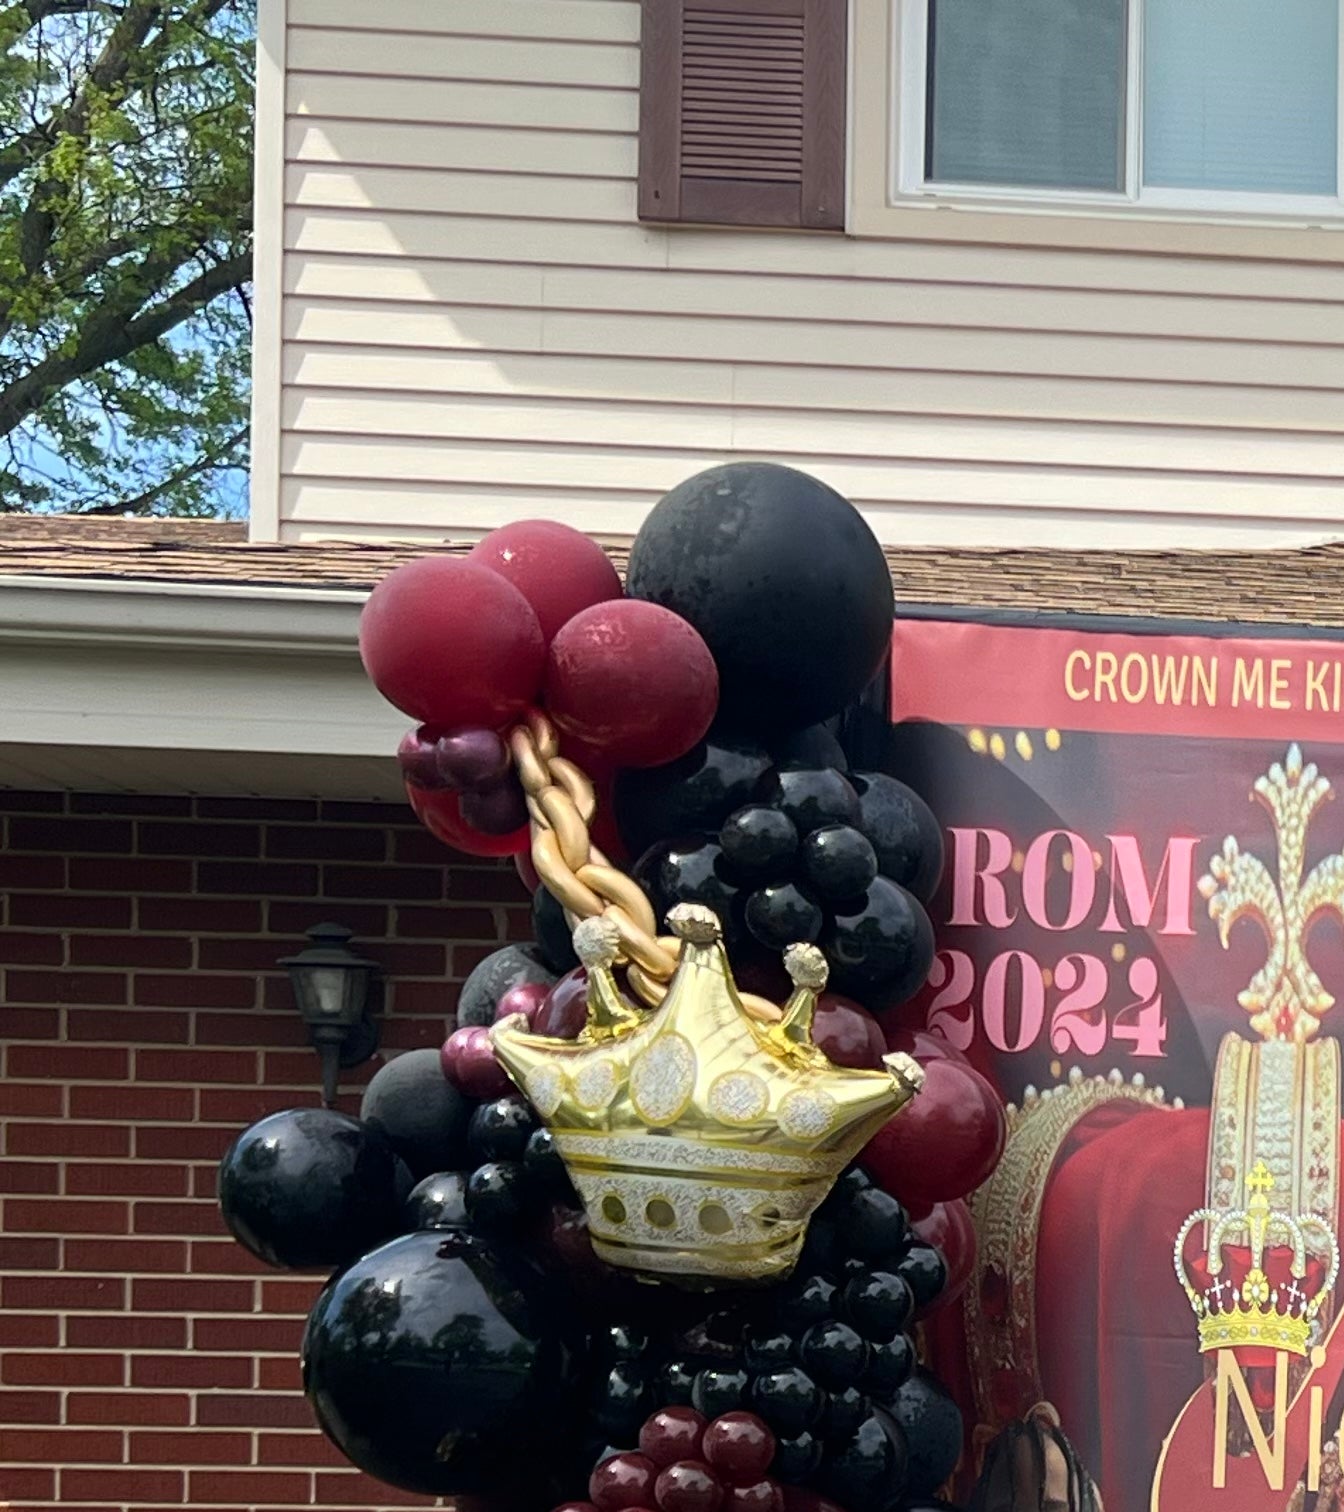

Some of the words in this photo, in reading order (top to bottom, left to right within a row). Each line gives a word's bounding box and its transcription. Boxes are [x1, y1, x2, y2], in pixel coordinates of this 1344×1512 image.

[1064, 649, 1218, 708] CROWN
[1230, 657, 1293, 709] ME
[944, 826, 1202, 936] ROM
[926, 949, 1168, 1058] 2024
